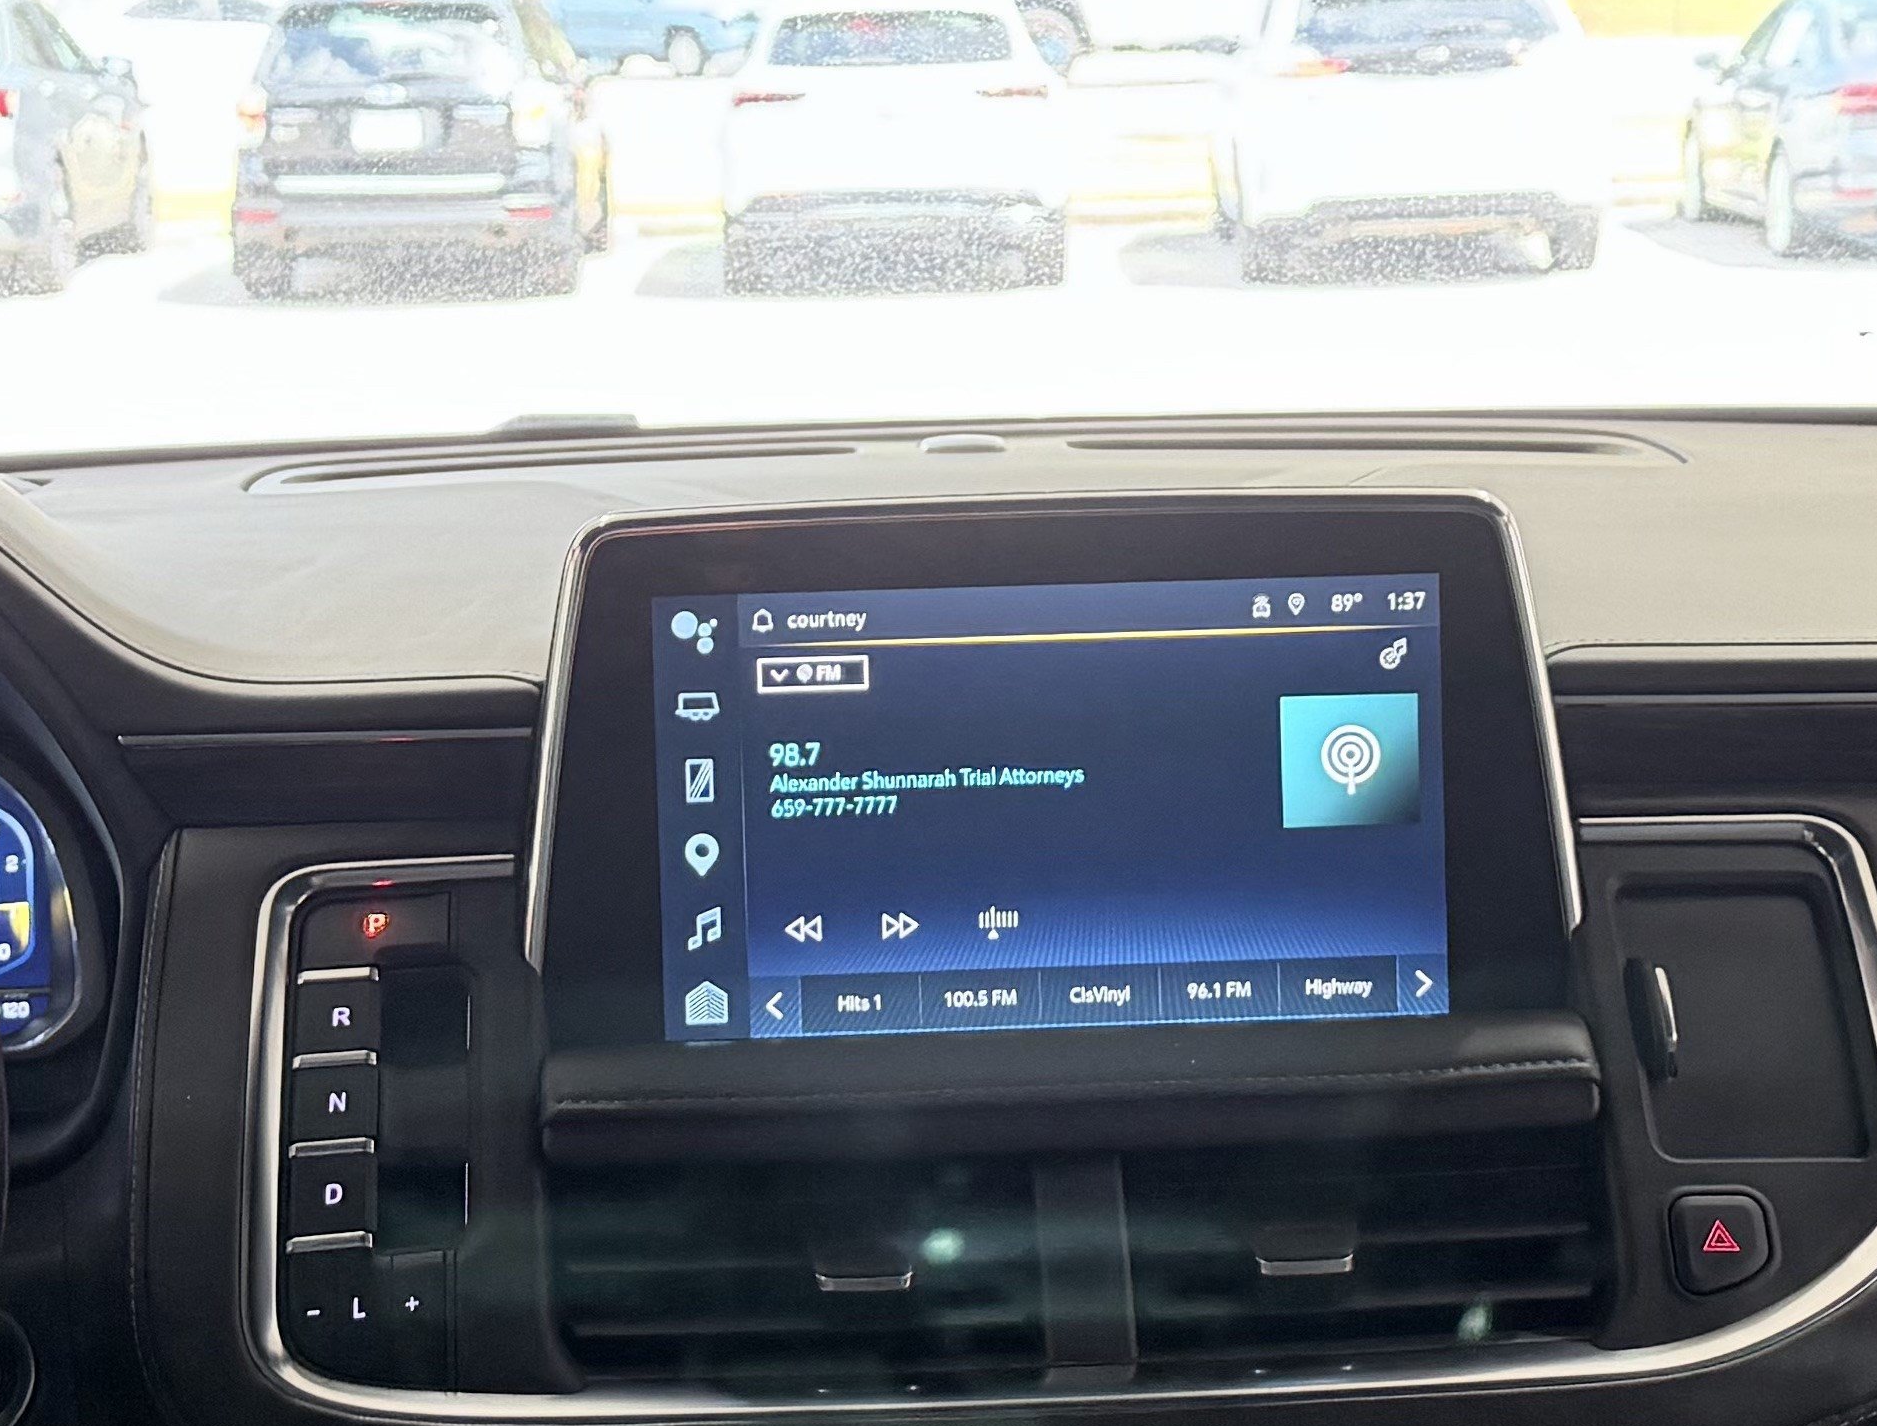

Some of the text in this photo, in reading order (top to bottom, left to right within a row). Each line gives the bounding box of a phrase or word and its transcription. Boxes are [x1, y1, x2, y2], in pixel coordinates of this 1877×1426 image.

[1330, 592, 1363, 612] 89°
[1386, 591, 1426, 611] 1:37
[786, 609, 867, 632] courtney
[816, 664, 842, 681] FM
[769, 741, 821, 767] 98.7
[769, 767, 1085, 794] Alexander Shunnarah Trial Attorneys
[771, 795, 898, 819] 659-777-7777
[5, 855, 19, 873] 2
[364, 913, 387, 933] P
[1186, 981, 1253, 1000] 96.1 FM
[1304, 977, 1373, 999] Highway
[836, 994, 882, 1013] Hits 1
[943, 989, 1018, 1008] 100.5 FM
[331, 1007, 351, 1027] R
[329, 1091, 347, 1113] N
[324, 1183, 343, 1205] D
[352, 1297, 366, 1319] L
